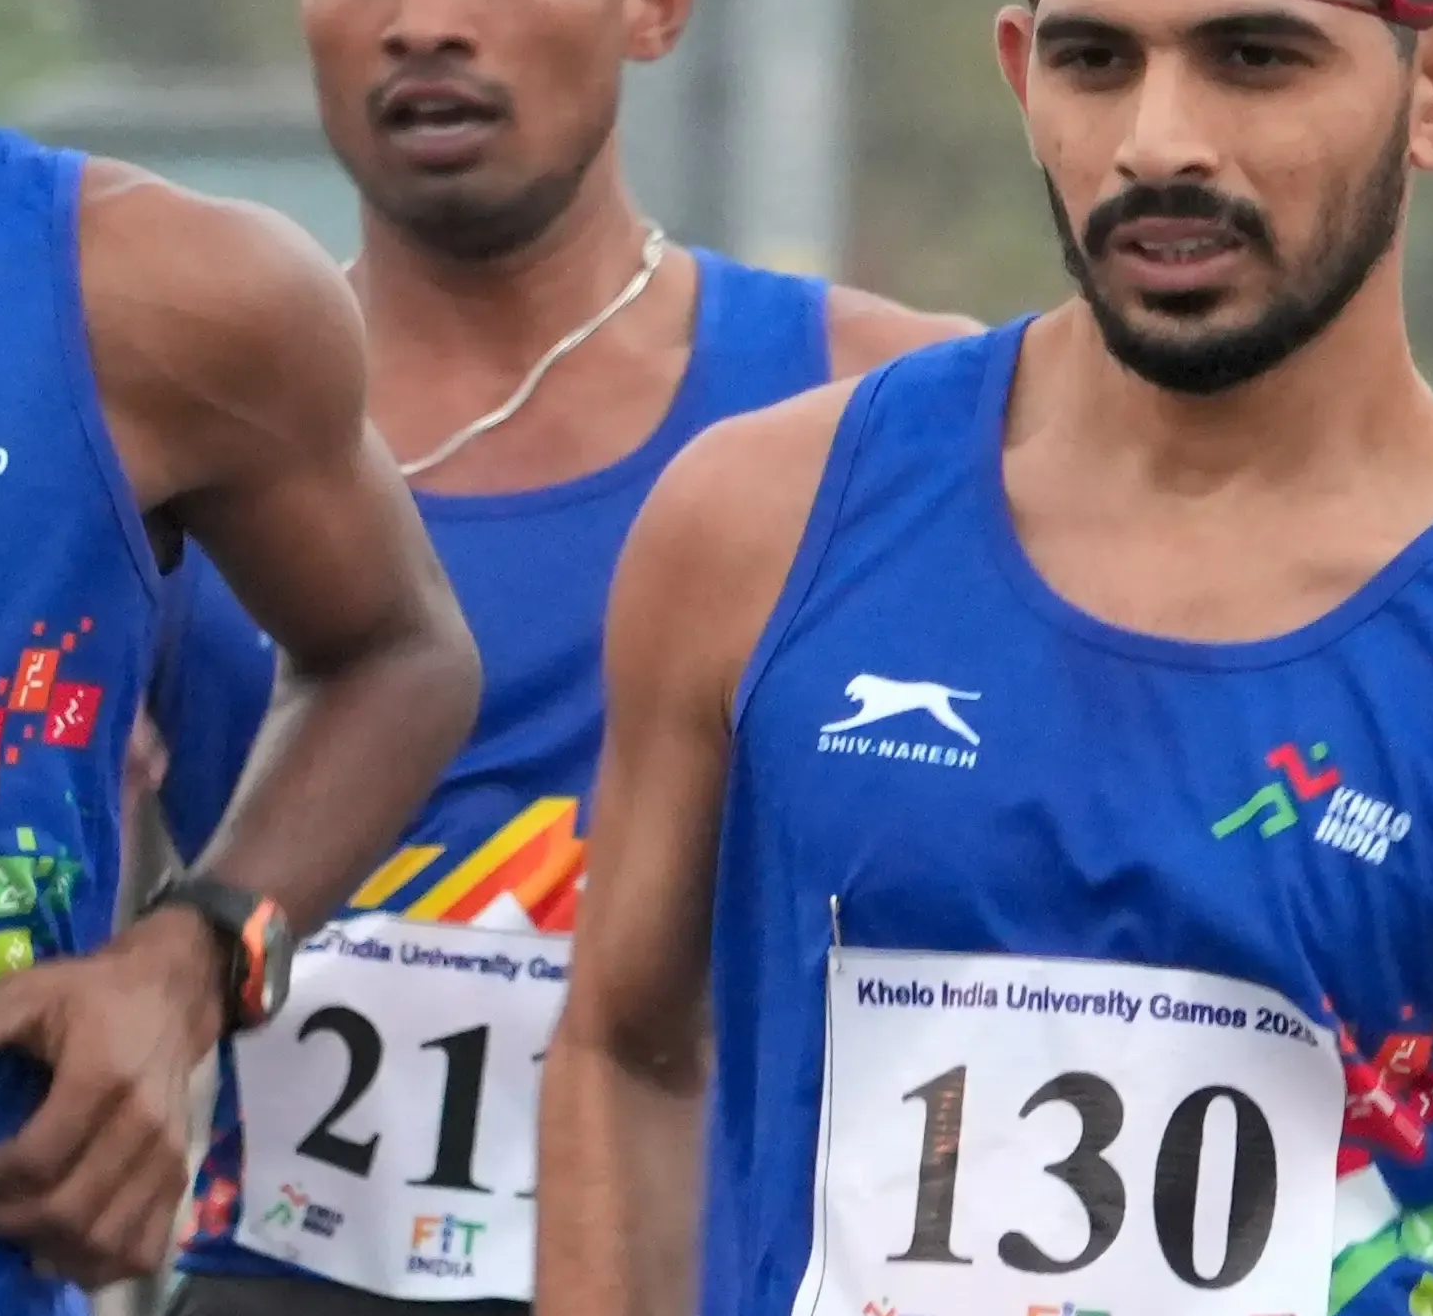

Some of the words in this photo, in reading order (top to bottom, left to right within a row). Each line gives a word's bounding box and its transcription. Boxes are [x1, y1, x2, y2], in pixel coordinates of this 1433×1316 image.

[1314, 815, 1390, 865] INDIA
[1327, 787, 1412, 842] KHELO
[858, 979, 934, 1006] Khelo
[942, 981, 998, 1007] India
[1006, 983, 1142, 1022] University
[1149, 994, 1247, 1028] Games
[295, 1004, 545, 1199] 21
[886, 1065, 1278, 1290] 130
